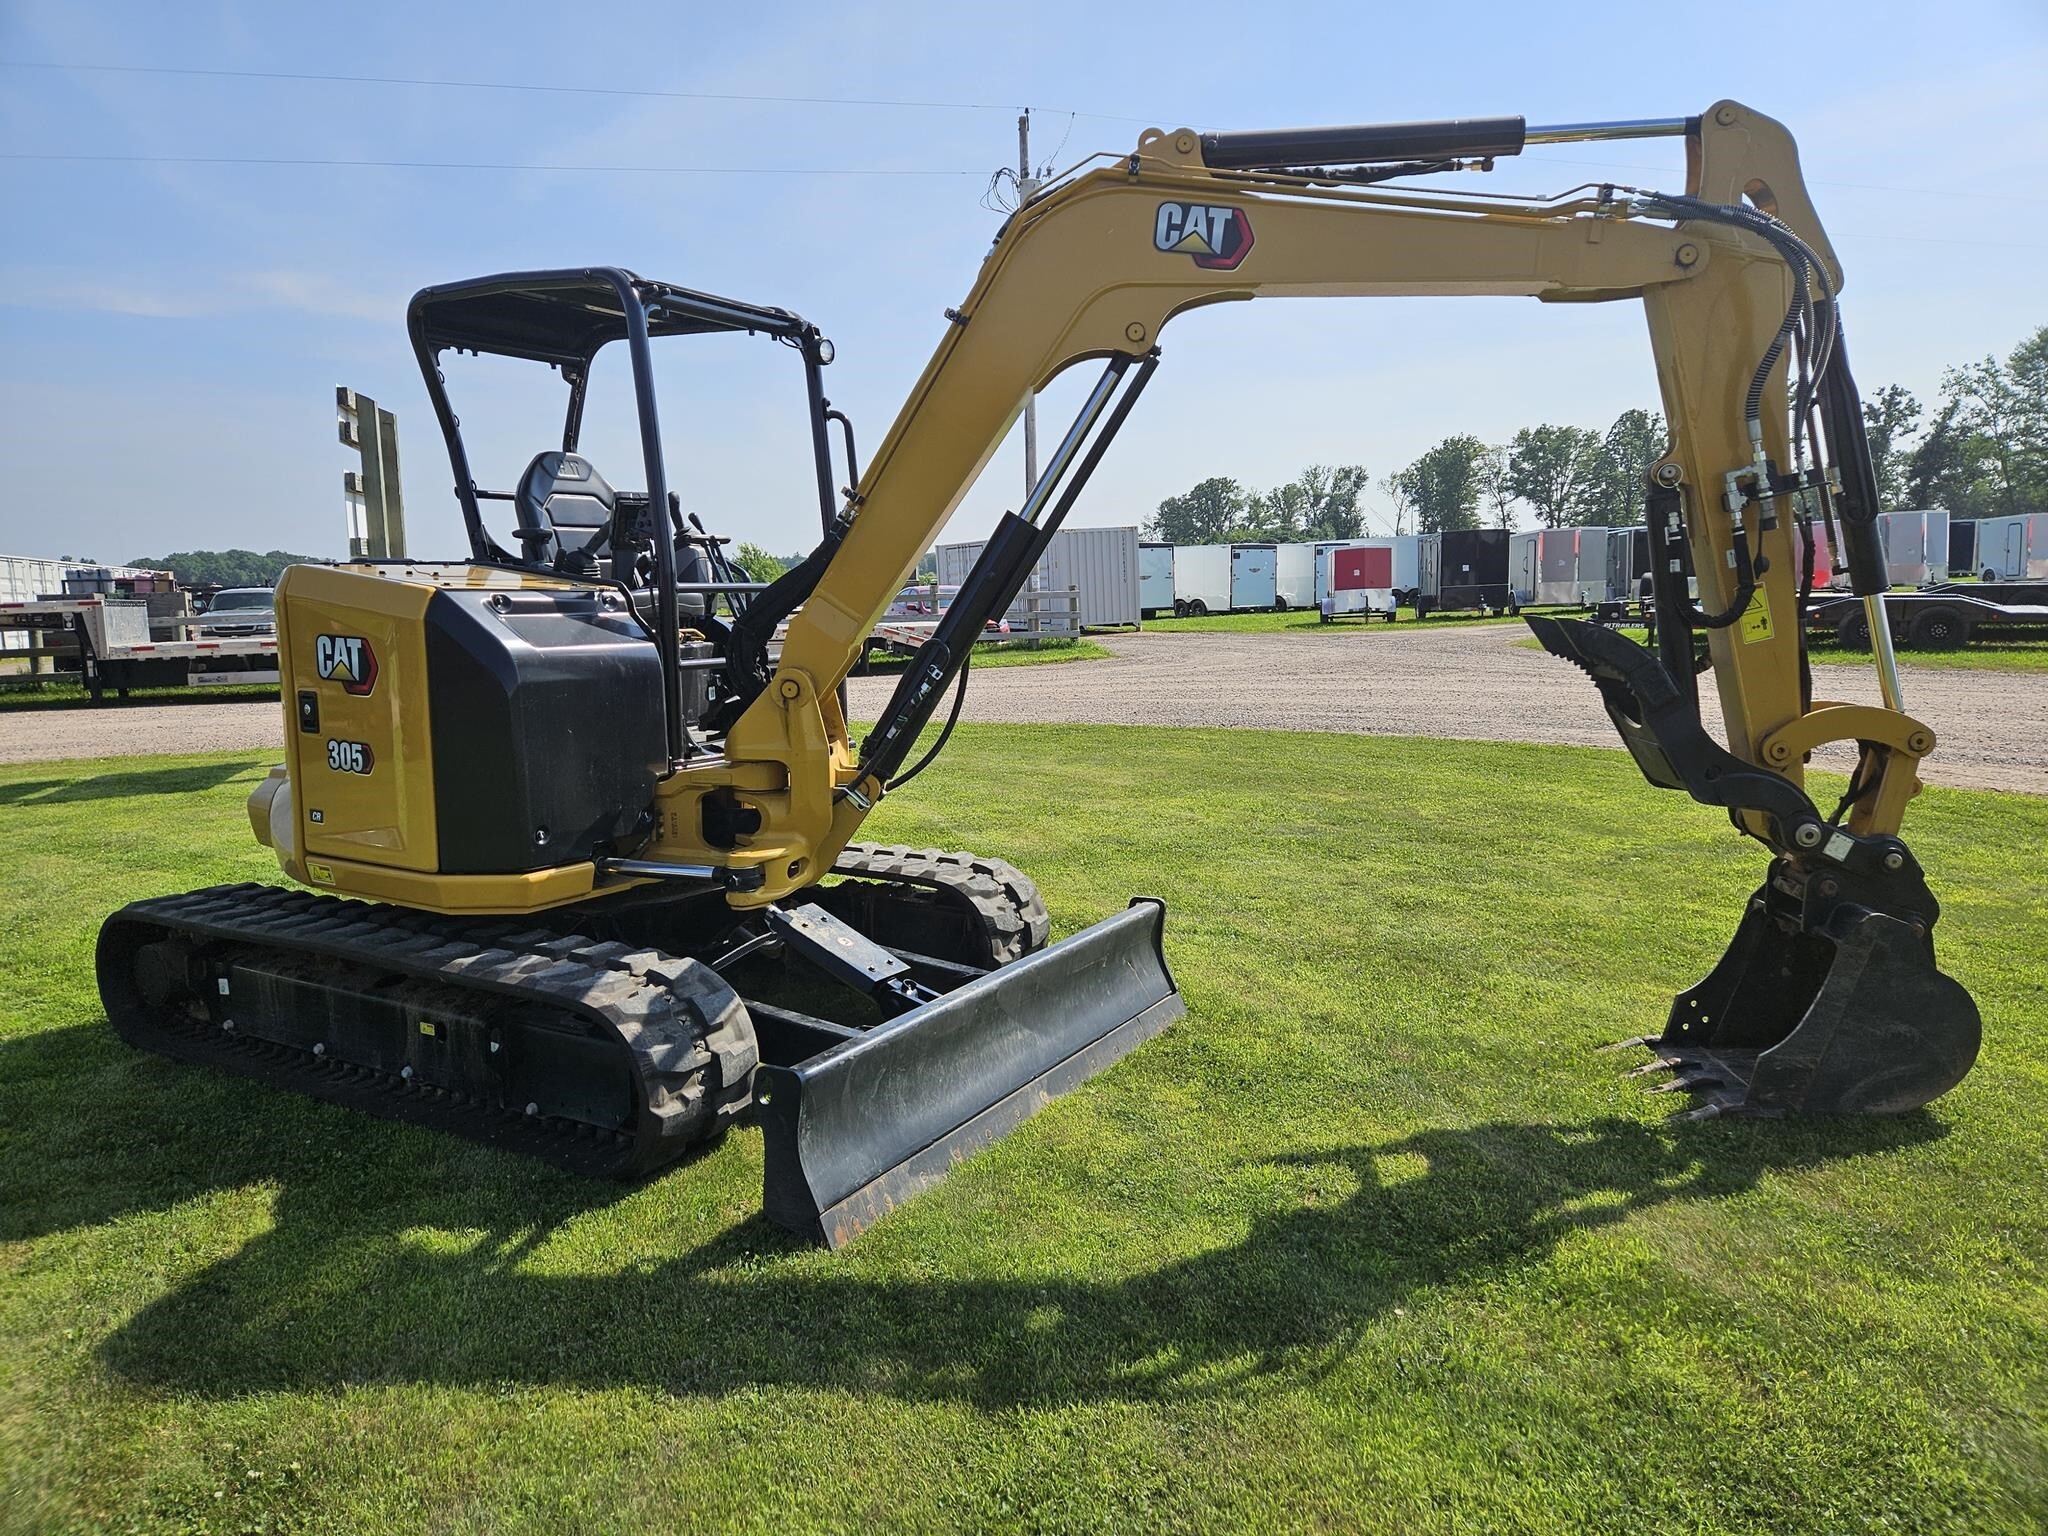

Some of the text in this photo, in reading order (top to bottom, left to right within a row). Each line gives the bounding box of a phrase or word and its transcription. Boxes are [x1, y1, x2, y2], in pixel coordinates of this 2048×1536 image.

[1155, 202, 1233, 255] CAT
[317, 635, 362, 681] CAT
[328, 740, 363, 772] 305
[312, 811, 321, 821] CR
